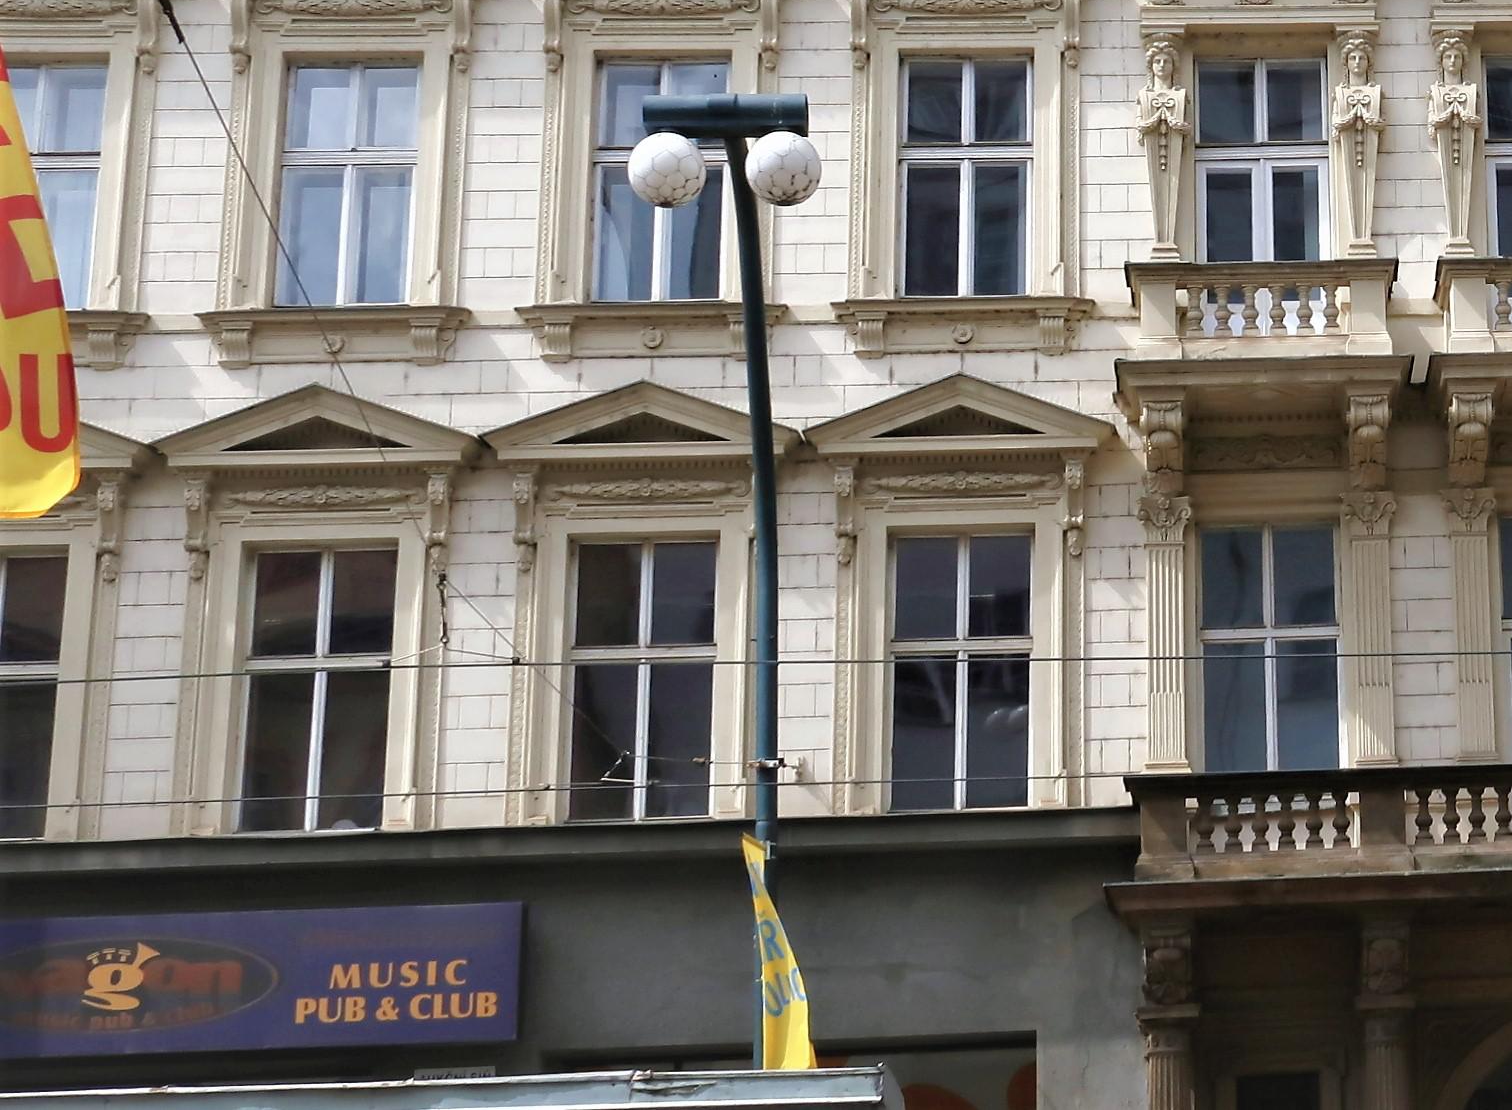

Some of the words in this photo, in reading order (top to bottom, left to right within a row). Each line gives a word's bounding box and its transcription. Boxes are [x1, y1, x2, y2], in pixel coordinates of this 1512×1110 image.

[329, 959, 468, 989] MUSIC
[295, 997, 366, 1024] PUB
[375, 997, 399, 1021] &
[409, 992, 498, 1020] CLUB
